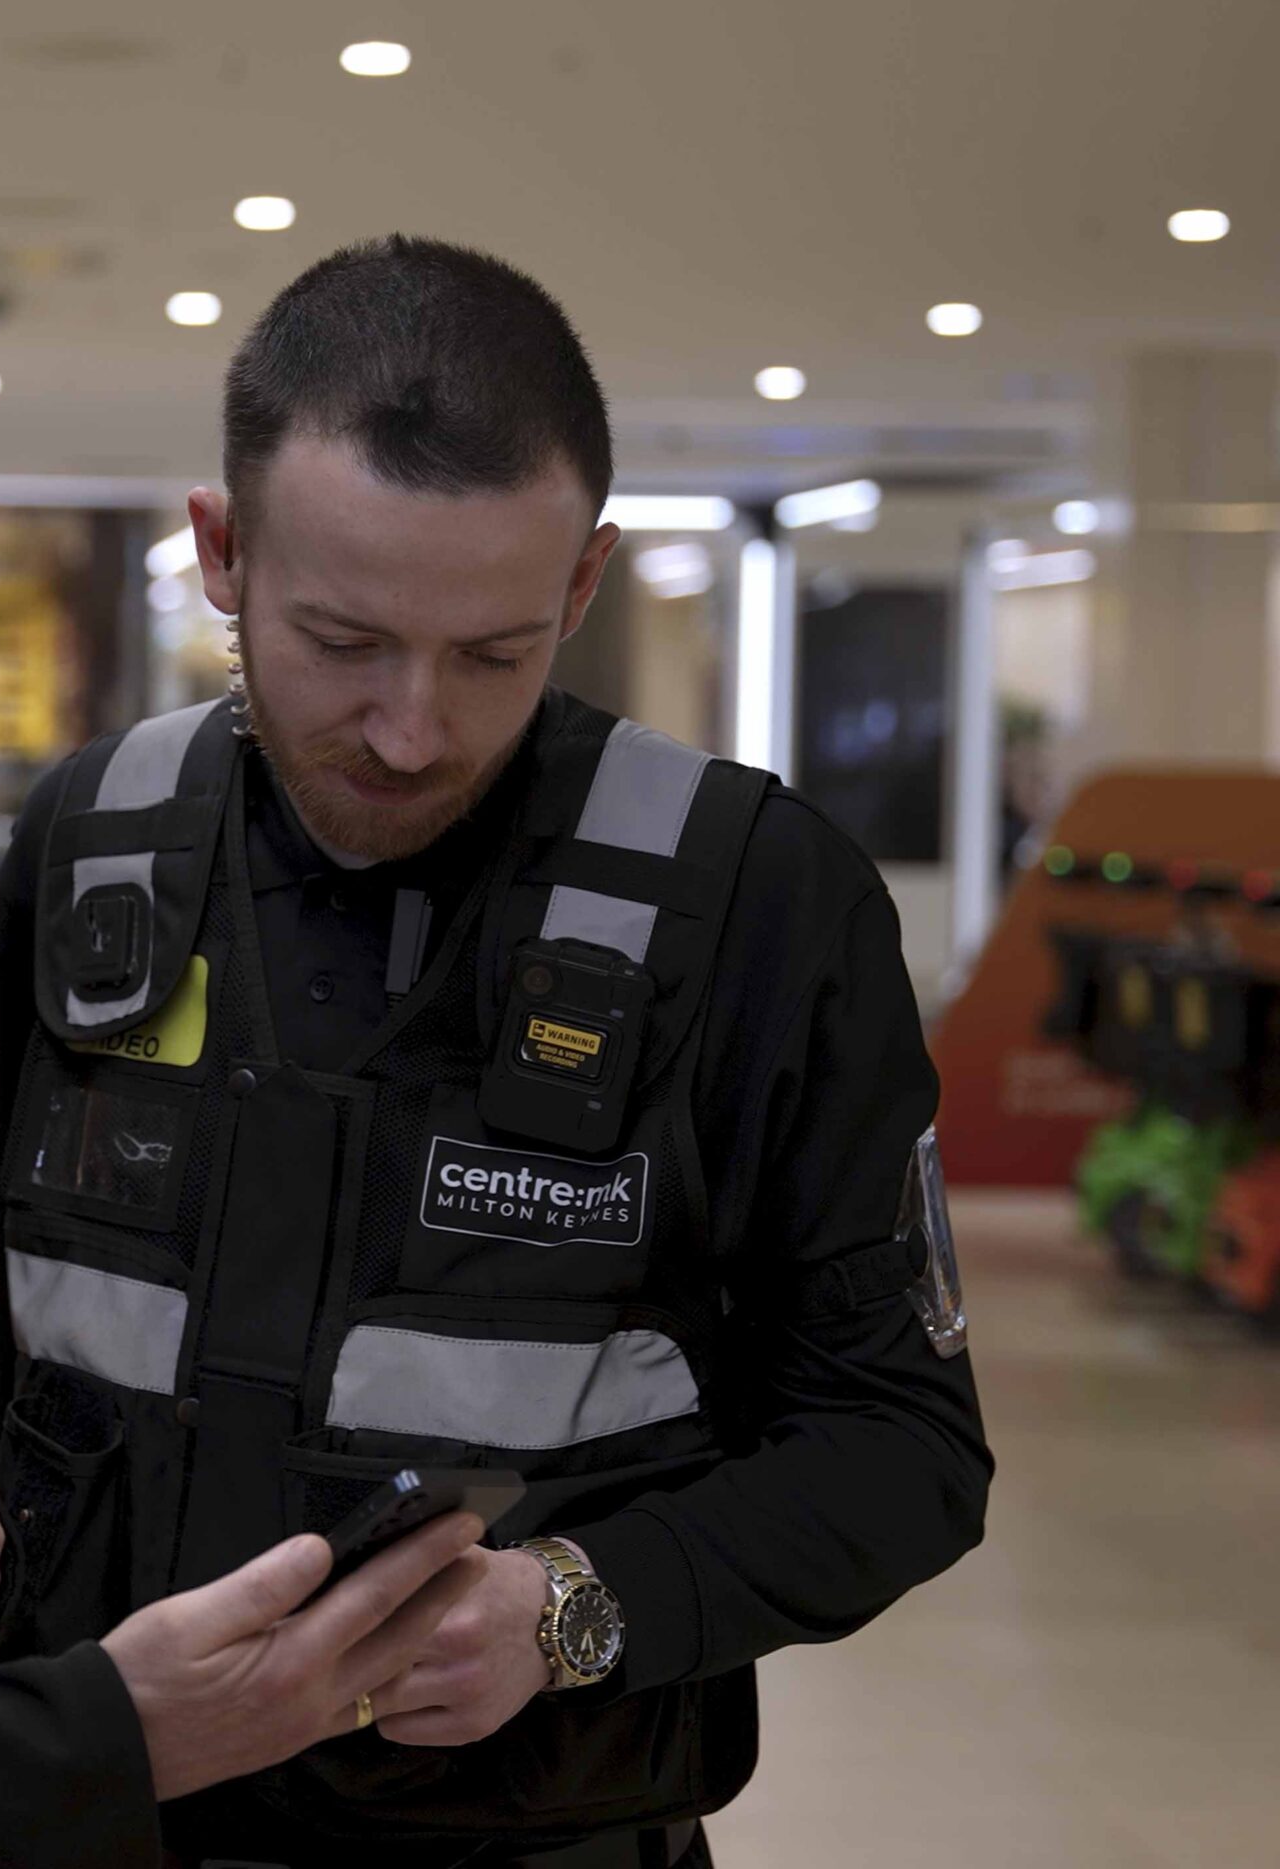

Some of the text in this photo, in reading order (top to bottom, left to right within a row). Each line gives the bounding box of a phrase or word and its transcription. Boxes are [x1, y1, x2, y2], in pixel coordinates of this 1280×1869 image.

[548, 1029, 596, 1050] WARNING
[440, 1163, 632, 1210] centre:mk
[437, 1193, 629, 1228] MILTON KEYNES
